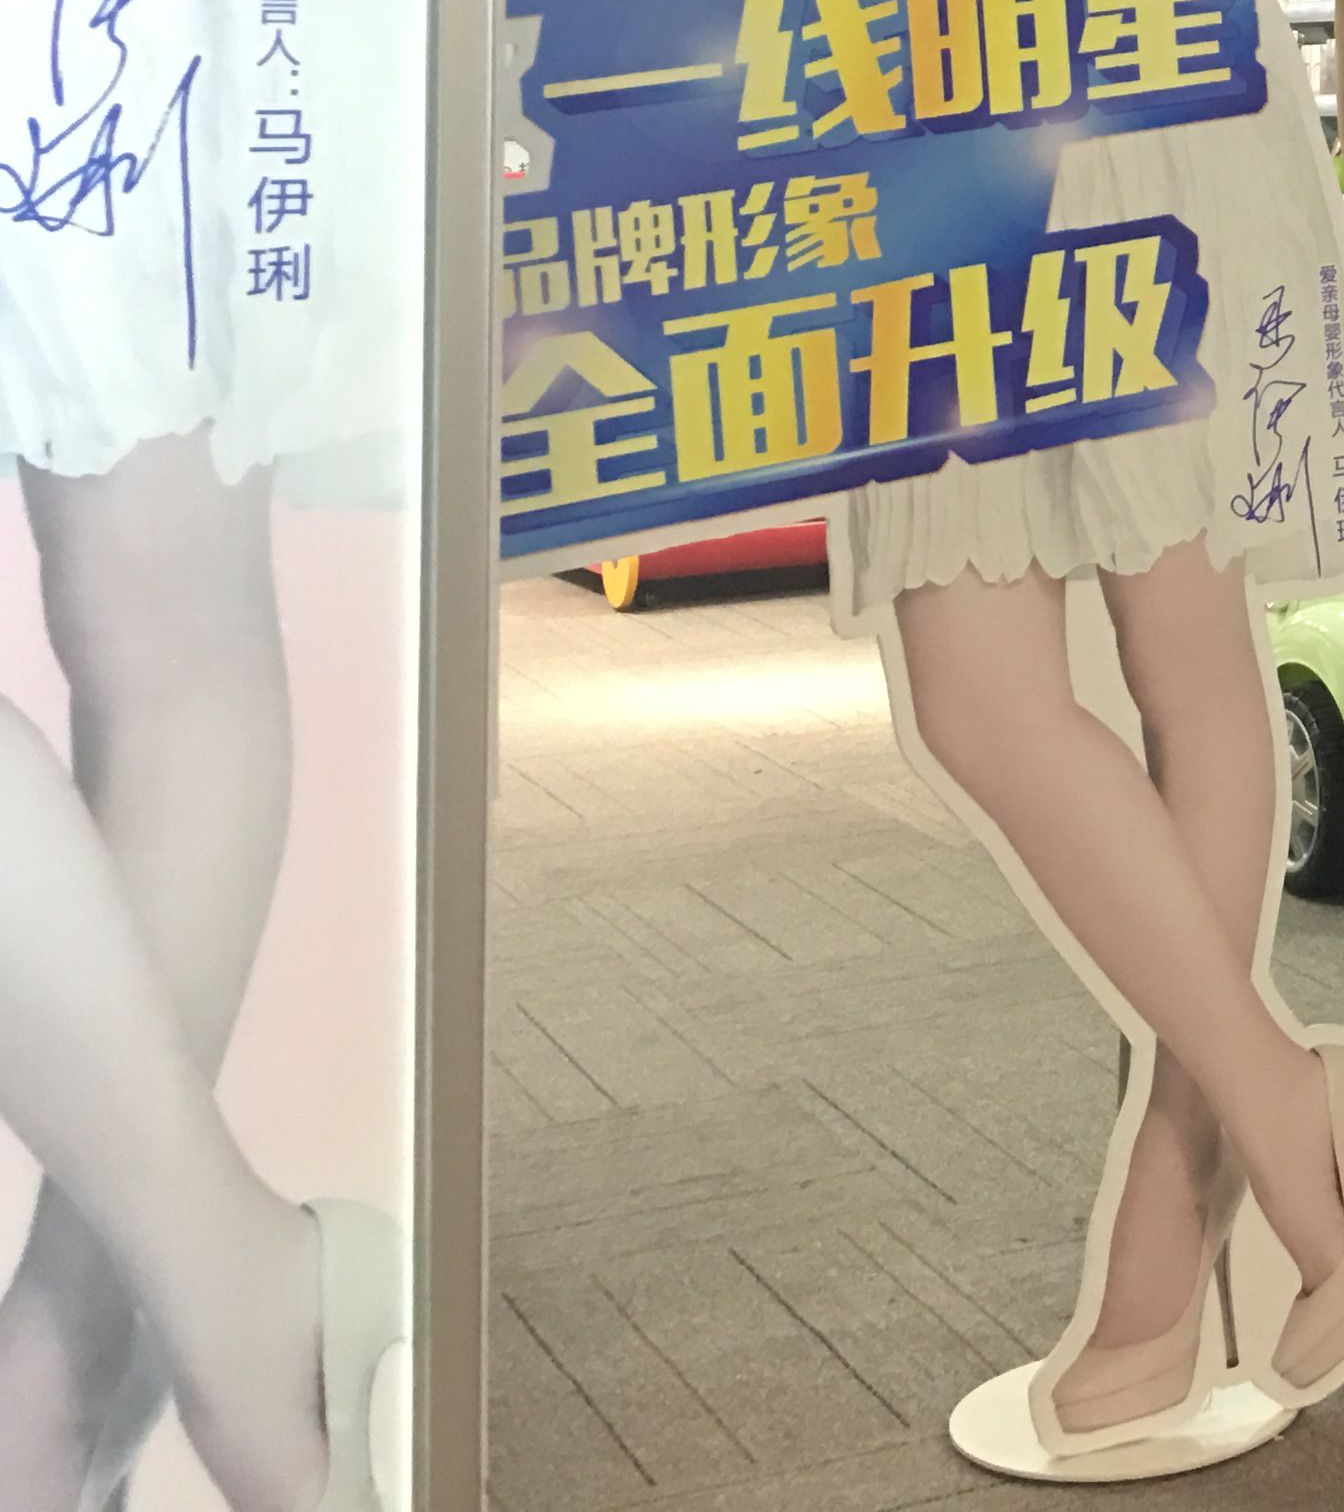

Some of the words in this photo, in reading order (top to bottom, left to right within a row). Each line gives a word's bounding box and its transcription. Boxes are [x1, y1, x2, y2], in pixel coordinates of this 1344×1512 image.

[501, 170, 883, 322] 品牌形象
[499, 234, 1180, 518] 全面升级
